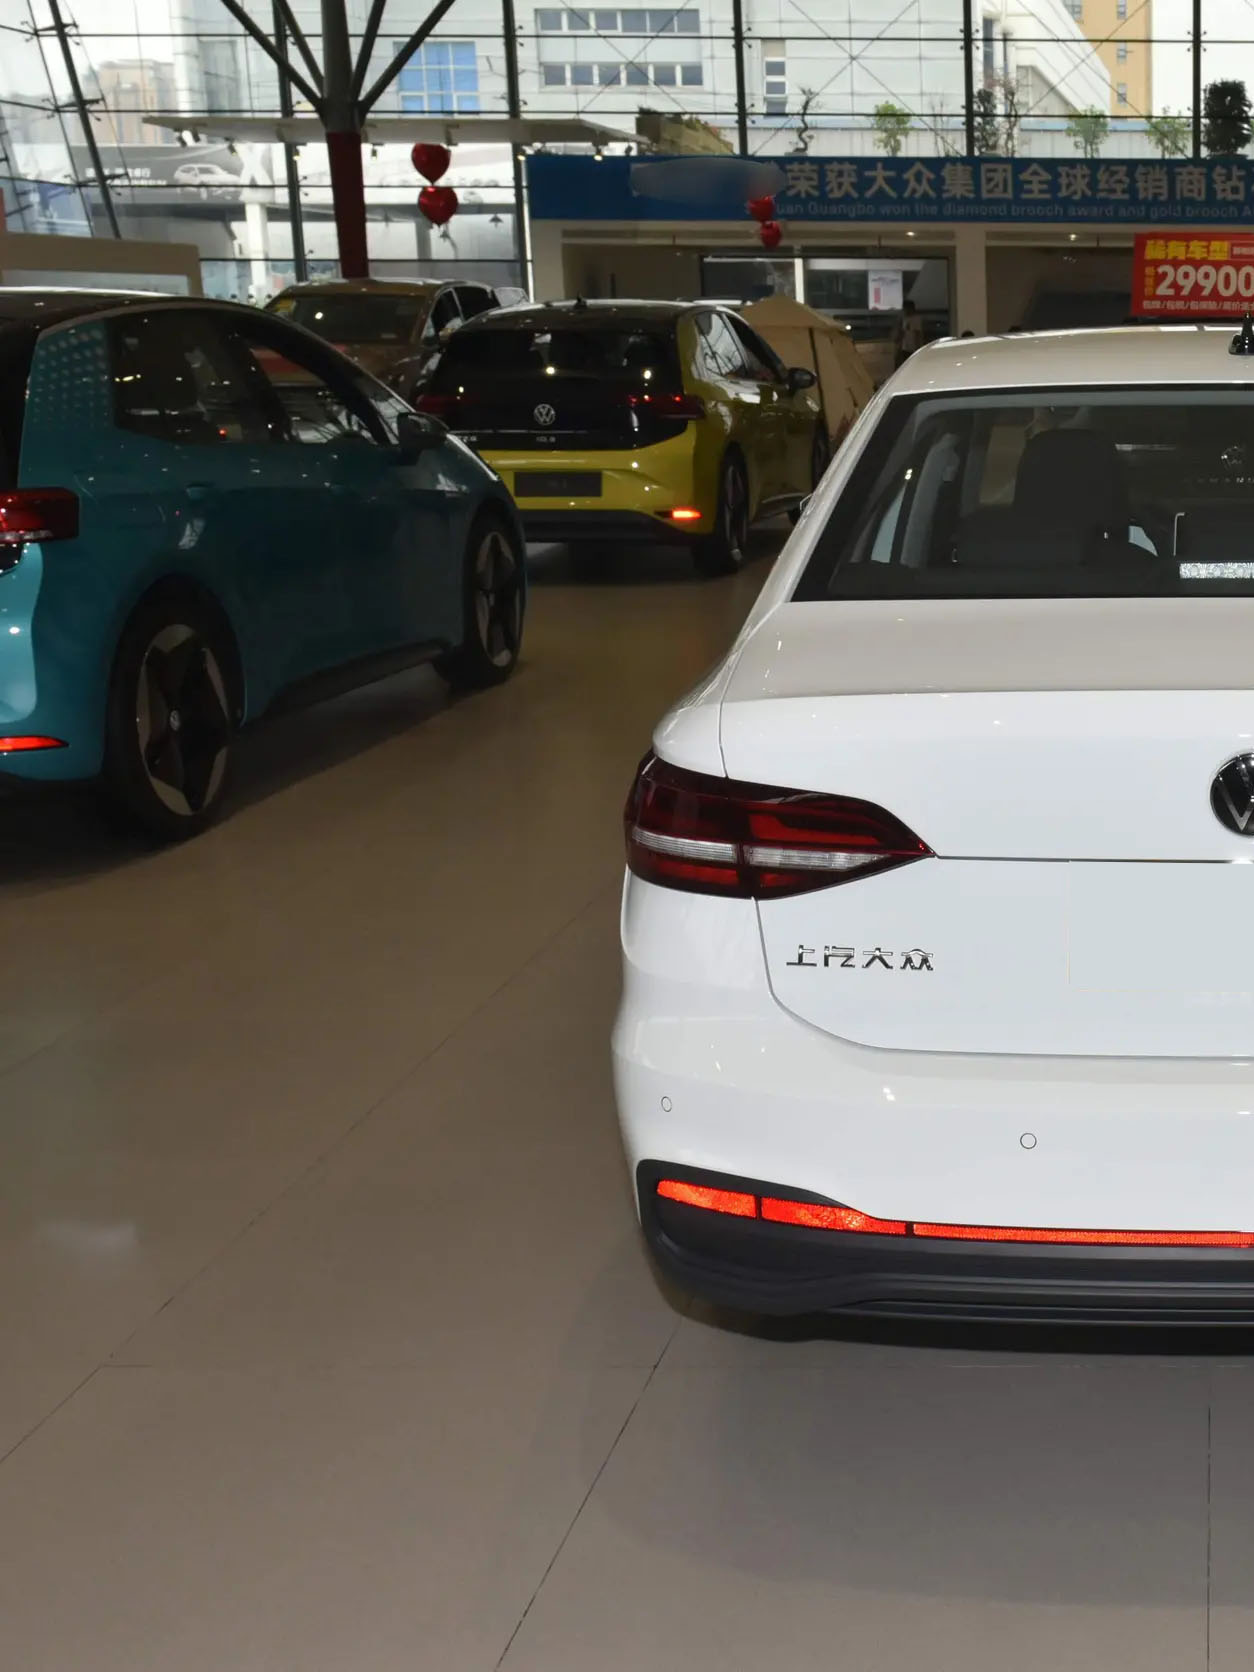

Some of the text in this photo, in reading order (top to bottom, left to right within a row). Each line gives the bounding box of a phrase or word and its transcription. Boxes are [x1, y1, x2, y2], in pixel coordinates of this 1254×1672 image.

[915, 203, 937, 216] the
[942, 203, 1007, 217] diamond
[786, 944, 934, 971] 上汽大众
